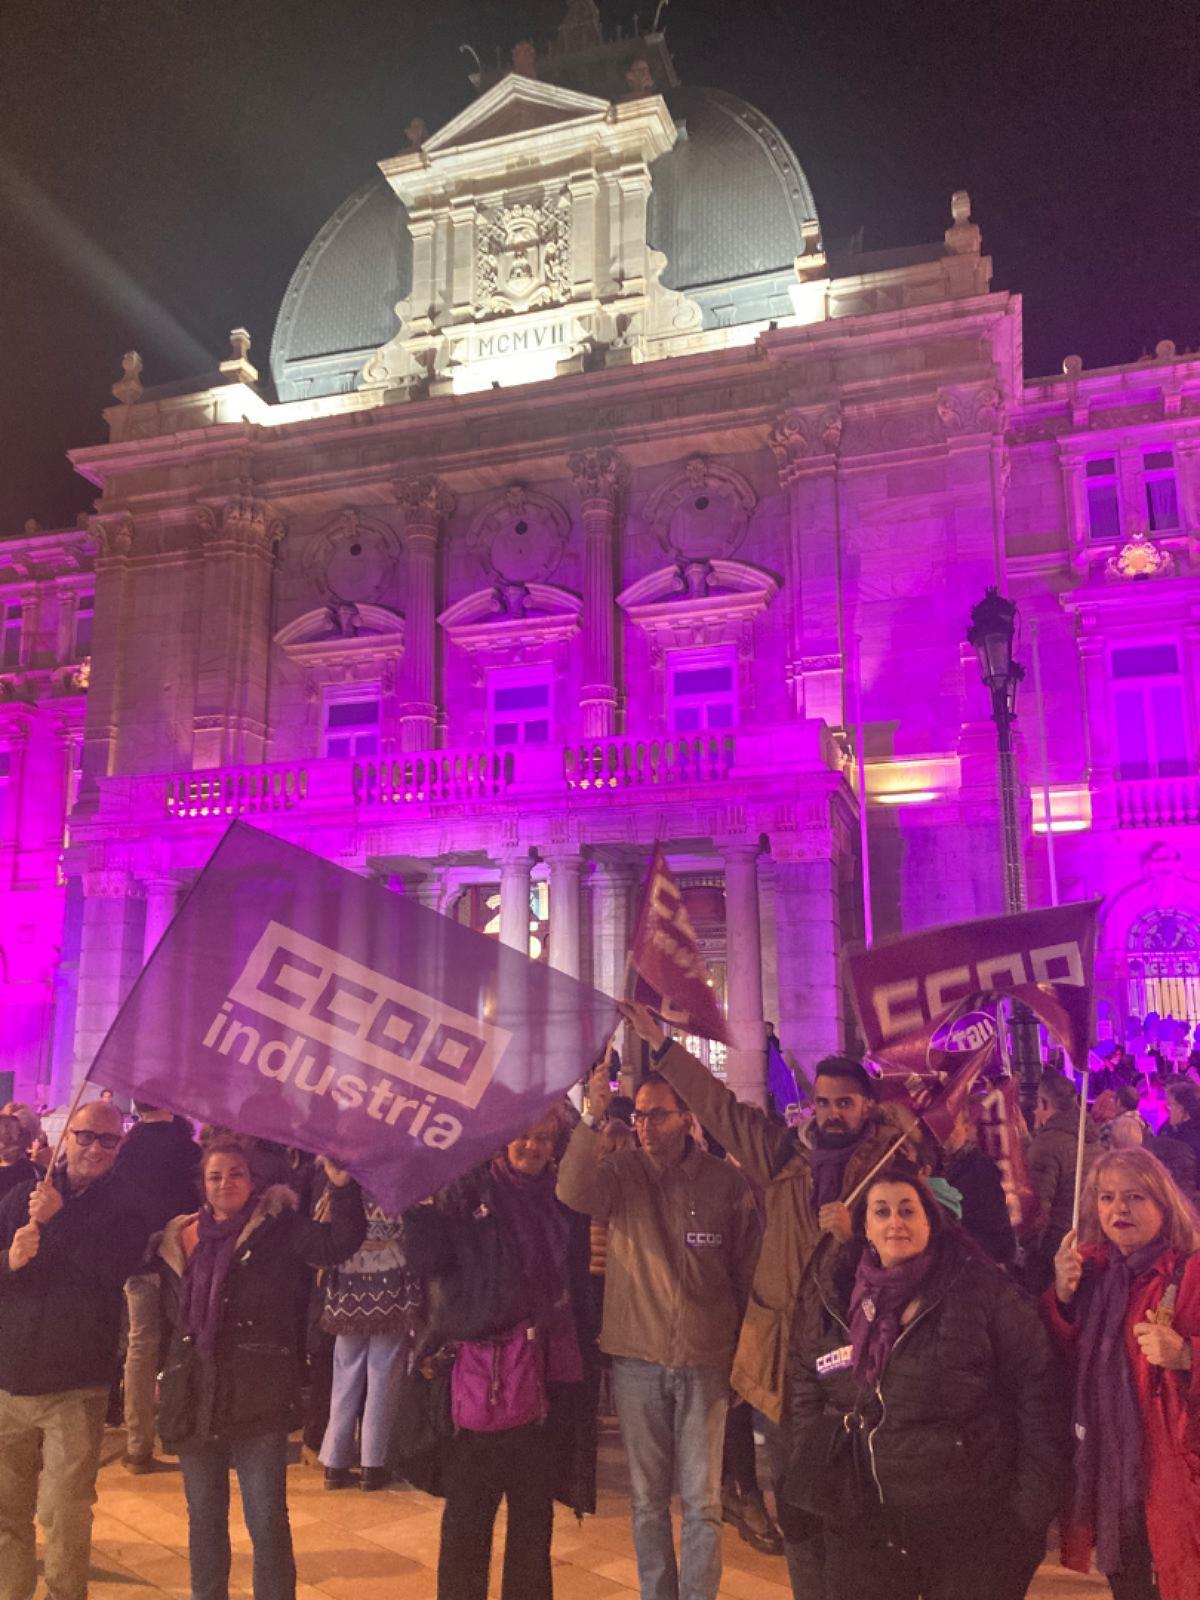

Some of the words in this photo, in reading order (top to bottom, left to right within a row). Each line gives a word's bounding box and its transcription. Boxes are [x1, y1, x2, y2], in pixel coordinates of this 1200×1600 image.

[479, 322, 565, 357] MCMVII
[202, 1001, 464, 1150] industria
[255, 945, 487, 1087] CCOO
